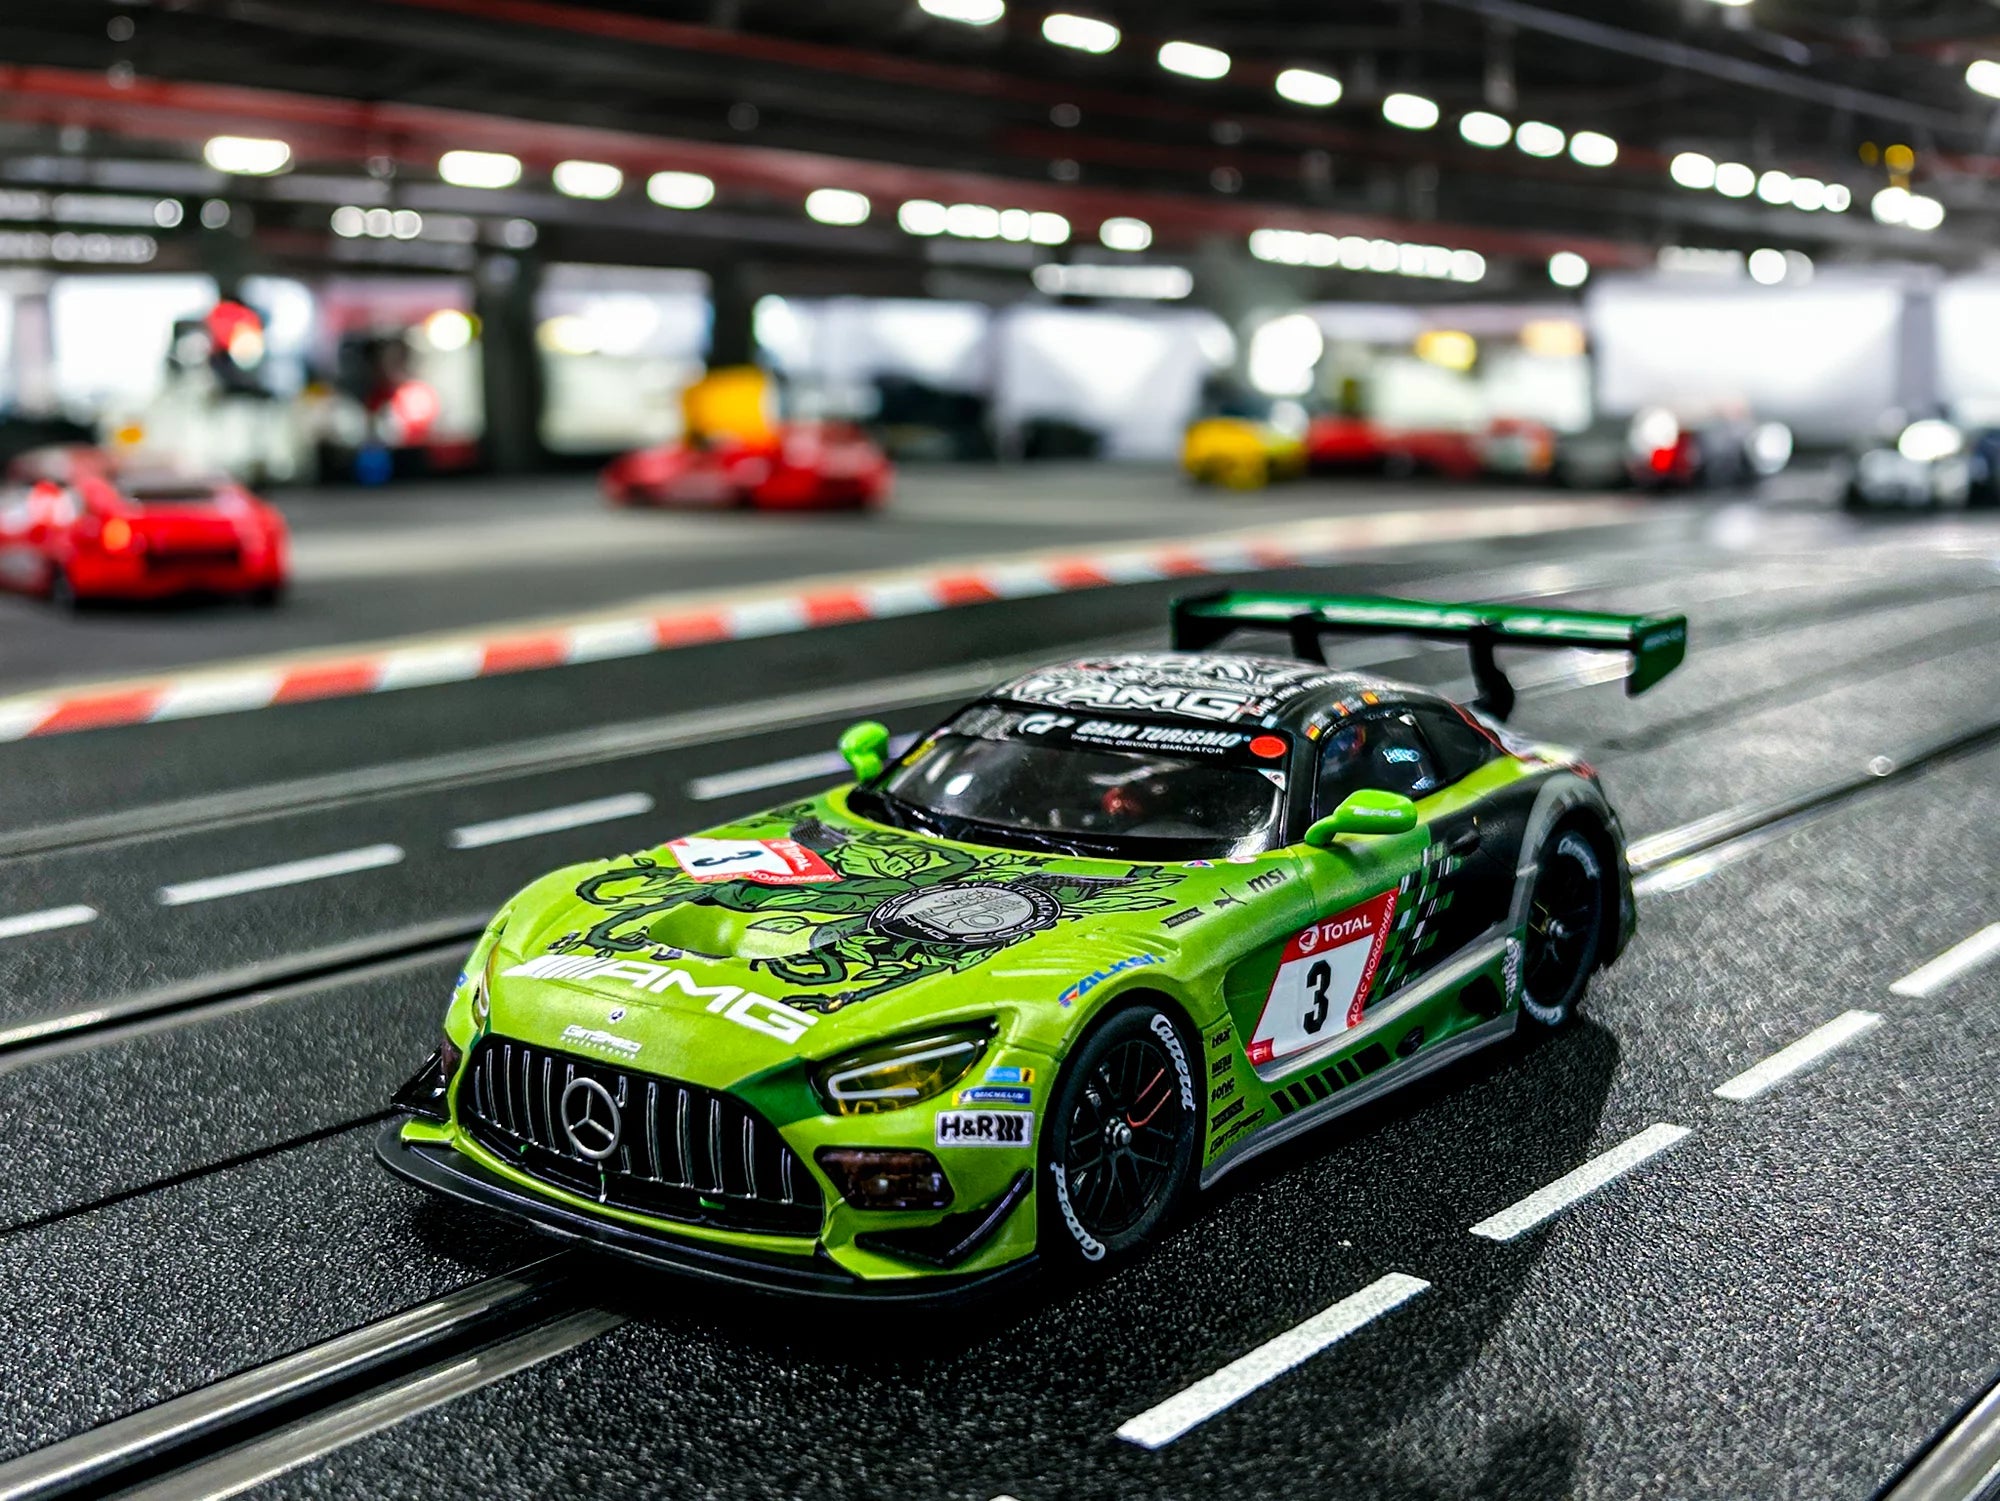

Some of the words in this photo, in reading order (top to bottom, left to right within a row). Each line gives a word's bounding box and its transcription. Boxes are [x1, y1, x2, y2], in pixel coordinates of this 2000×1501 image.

[1076, 720, 1139, 739] GRAN
[1136, 725, 1242, 748] TURISMO
[1115, 740, 1158, 750] DRIVING
[1159, 743, 1225, 755] SIMULATOR
[692, 850, 764, 867] 3
[746, 871, 836, 883] NORDRHEIN
[1322, 915, 1373, 942] TOTAL
[1349, 982, 1369, 1025] ADAC
[1365, 894, 1396, 981] NORDRHEIN
[579, 954, 819, 1044] AMG
[1303, 959, 1331, 1035] 3
[1150, 1014, 1196, 1111] Carrera
[940, 1115, 993, 1137] H&R
